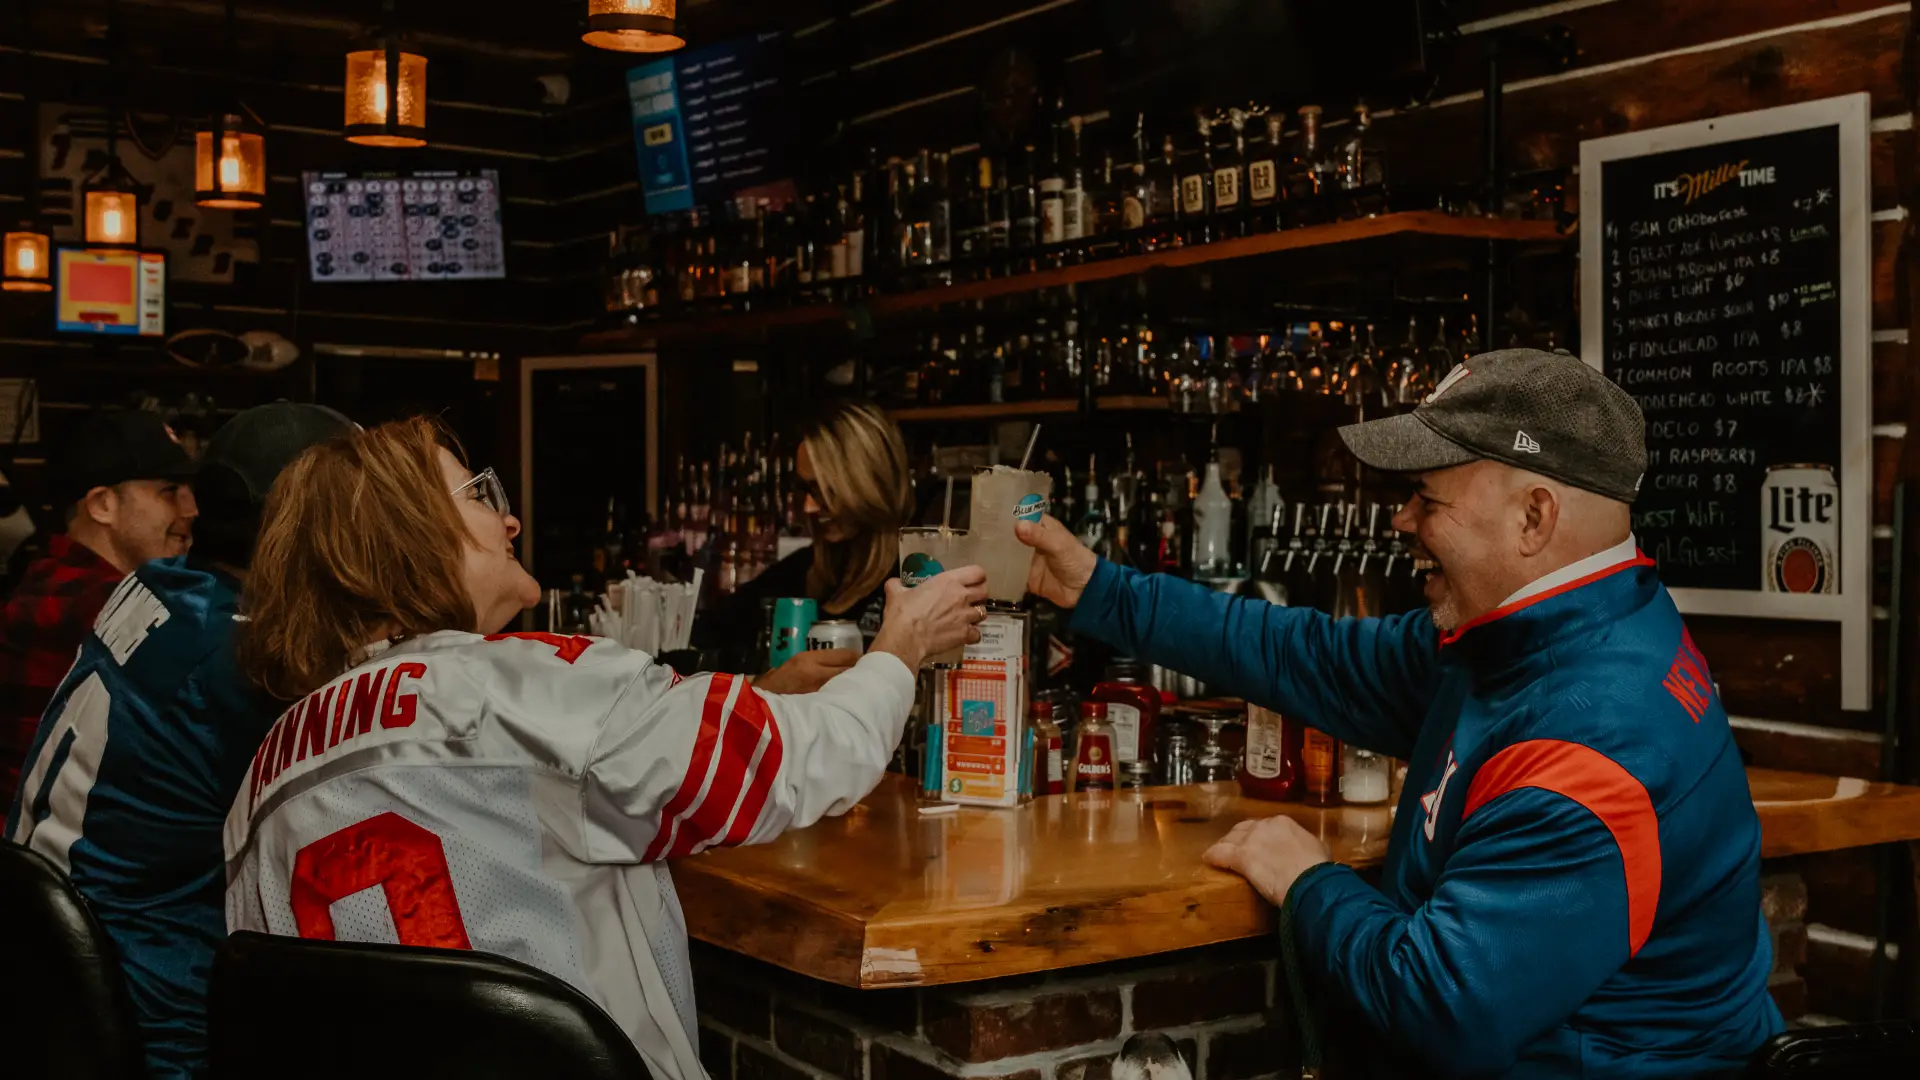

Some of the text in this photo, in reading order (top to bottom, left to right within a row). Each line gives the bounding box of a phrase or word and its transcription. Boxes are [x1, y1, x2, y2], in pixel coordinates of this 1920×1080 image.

[1654, 158, 1777, 206] IT'S Miller TIME
[1629, 220, 1661, 240] SAM
[1611, 249, 1621, 267] 2
[1628, 244, 1676, 267] GREAT
[1611, 270, 1622, 288] 3
[1630, 265, 1672, 285] JOHN
[1676, 260, 1728, 282] BROWN
[1671, 277, 1714, 299] LIGHT
[1733, 331, 1760, 348] IPA
[1627, 365, 1692, 385] COMMON
[1711, 360, 1769, 379] ROOTS
[1780, 358, 1807, 376] IPA
[1727, 389, 1774, 407] WHITE
[1650, 417, 1738, 439] DELO $7
[1669, 447, 1756, 466] RASPBERRY
[1712, 473, 1737, 494] $8
[1769, 486, 1833, 533] Lite
